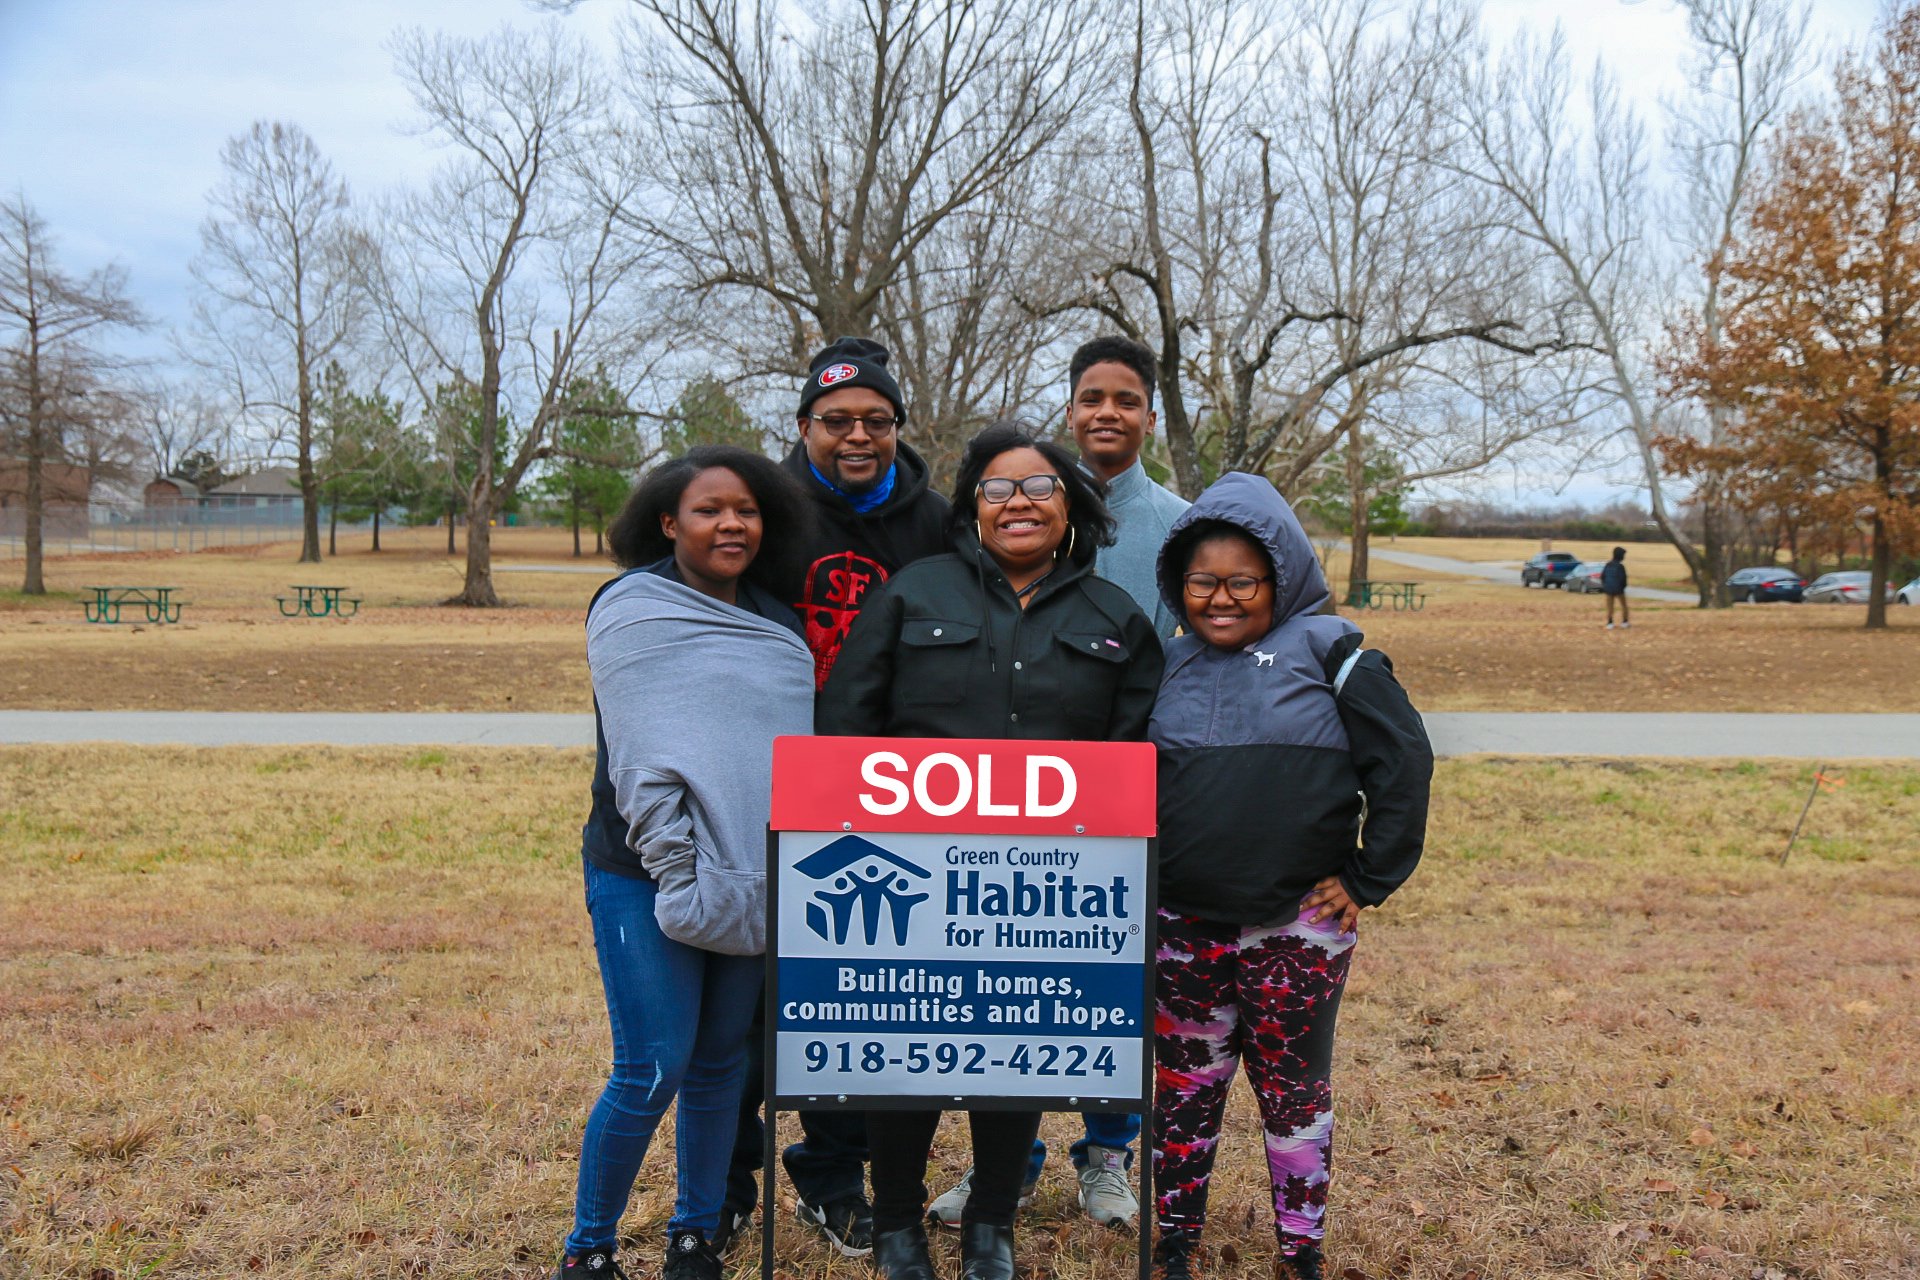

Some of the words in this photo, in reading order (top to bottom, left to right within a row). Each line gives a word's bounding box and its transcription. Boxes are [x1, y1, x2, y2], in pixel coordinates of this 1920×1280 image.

[825, 569, 870, 605] SF
[858, 751, 1078, 818] SOLD
[945, 845, 999, 866] Green
[1006, 846, 1080, 871] Country
[945, 869, 1130, 919] Habitat
[944, 921, 985, 948] for
[838, 967, 963, 999] Building
[976, 969, 1082, 1000] homes,
[783, 997, 974, 1023] communities
[987, 999, 1040, 1024] and
[1053, 999, 1135, 1031] hope.
[804, 1040, 1117, 1078] 918-592-4224
